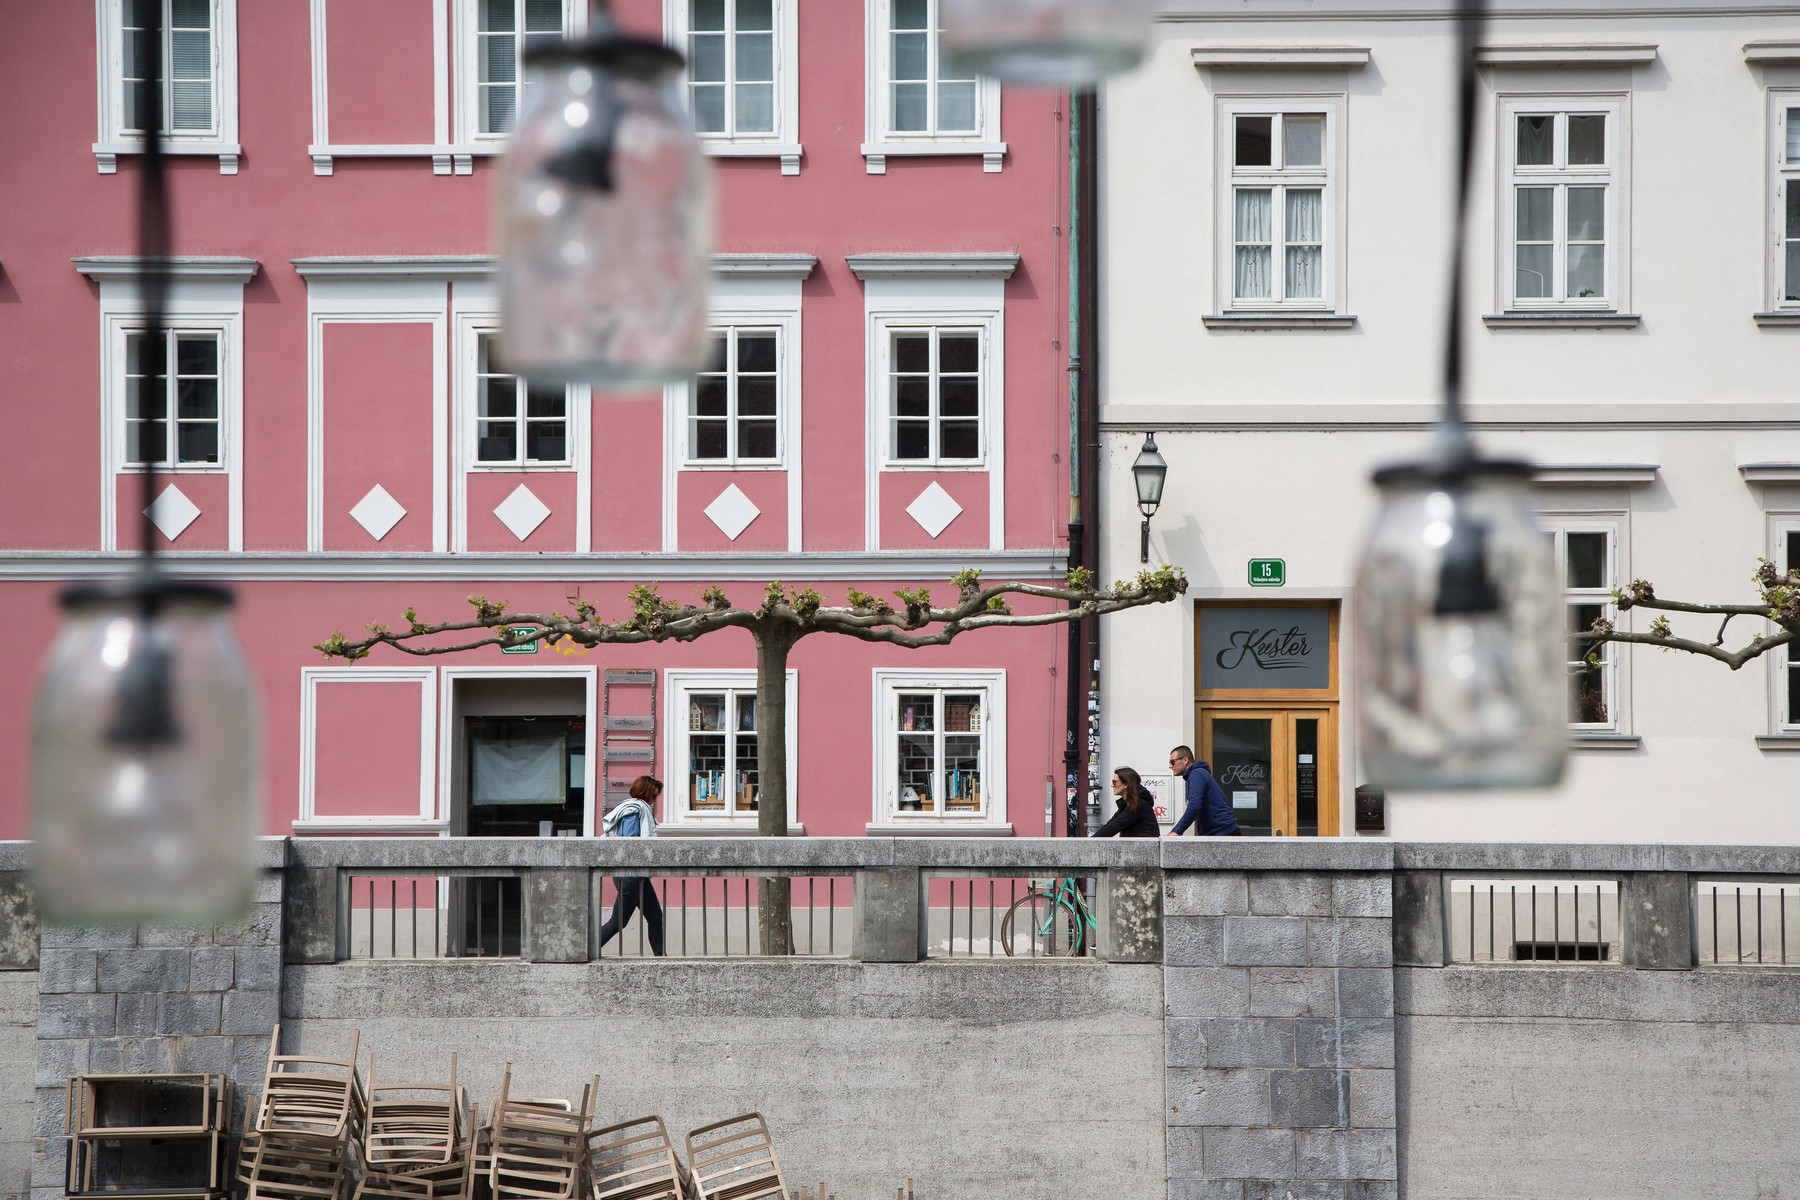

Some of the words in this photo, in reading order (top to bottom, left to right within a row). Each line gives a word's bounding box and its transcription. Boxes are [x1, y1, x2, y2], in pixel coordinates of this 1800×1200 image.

[1261, 563, 1272, 577] 15
[1216, 625, 1313, 670] Kuster
[1220, 763, 1266, 785] Kuster
